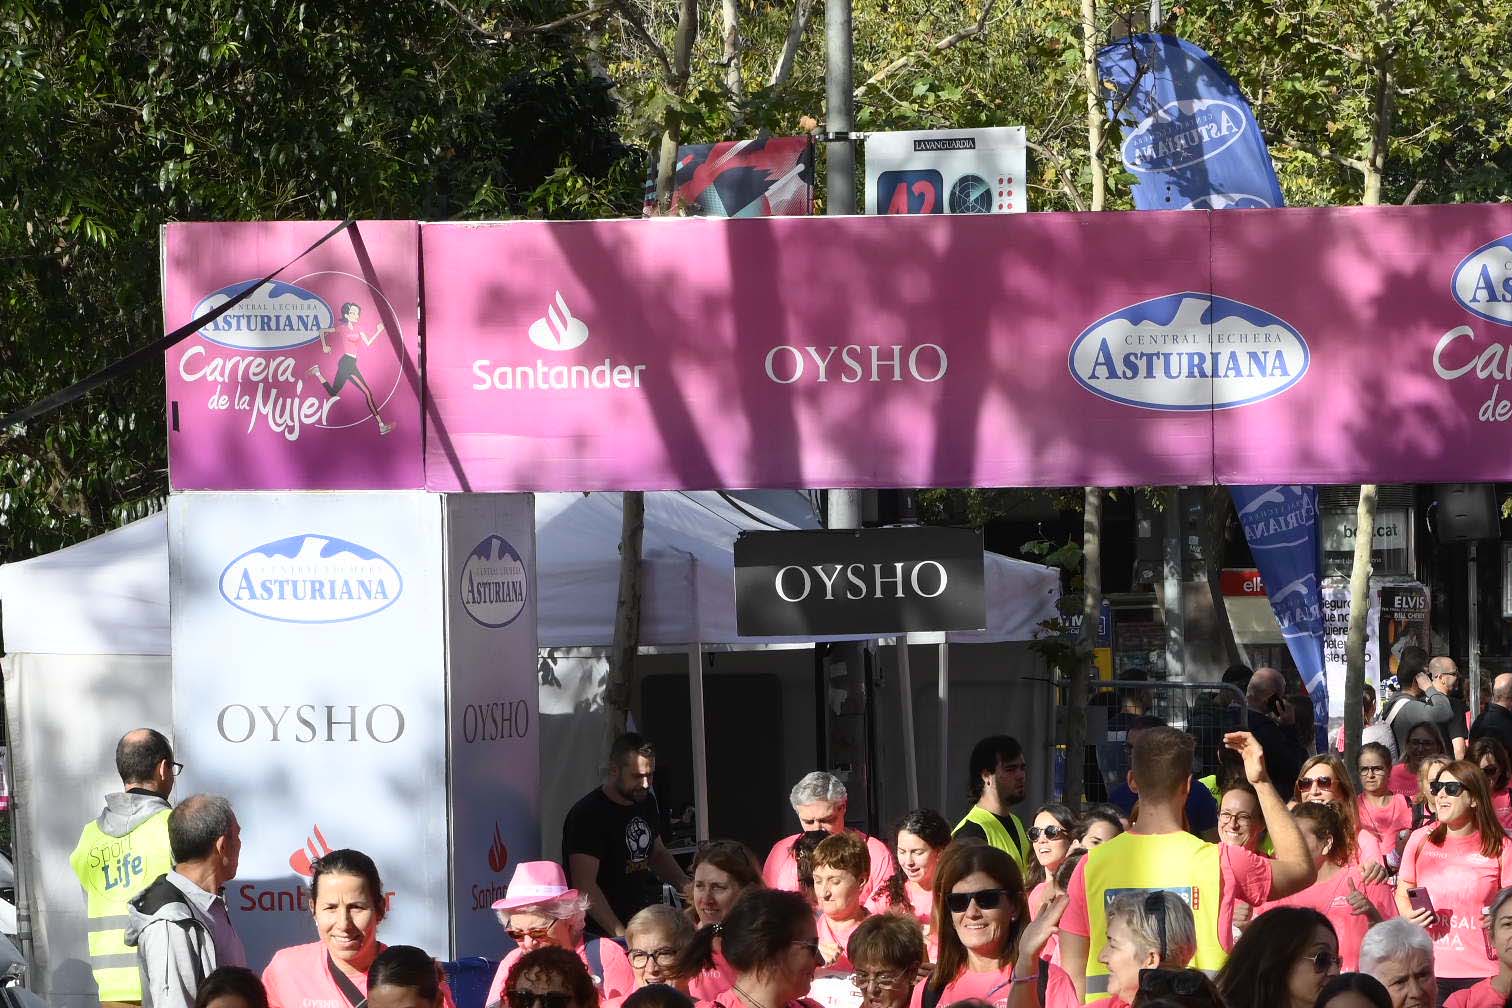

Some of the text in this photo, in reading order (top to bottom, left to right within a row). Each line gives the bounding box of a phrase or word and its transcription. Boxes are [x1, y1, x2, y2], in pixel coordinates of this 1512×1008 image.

[925, 138, 975, 150] VANGUARDIA
[1124, 331, 1282, 346] CENTRAL LECHERA
[179, 345, 296, 383] Carrera
[472, 357, 646, 392] Santander
[764, 342, 948, 385] OYSHO
[1088, 336, 1290, 380] ASTURIANA
[208, 380, 341, 441] de la Mujer
[1478, 386, 1512, 422] de
[233, 567, 389, 601] ASTURIANA
[465, 573, 524, 607] ASTURIANA
[774, 560, 949, 602] OYSHO
[216, 703, 406, 744] OYSHO
[462, 699, 529, 744] OYSHO
[89, 836, 133, 869] Sport
[102, 852, 144, 891] Life
